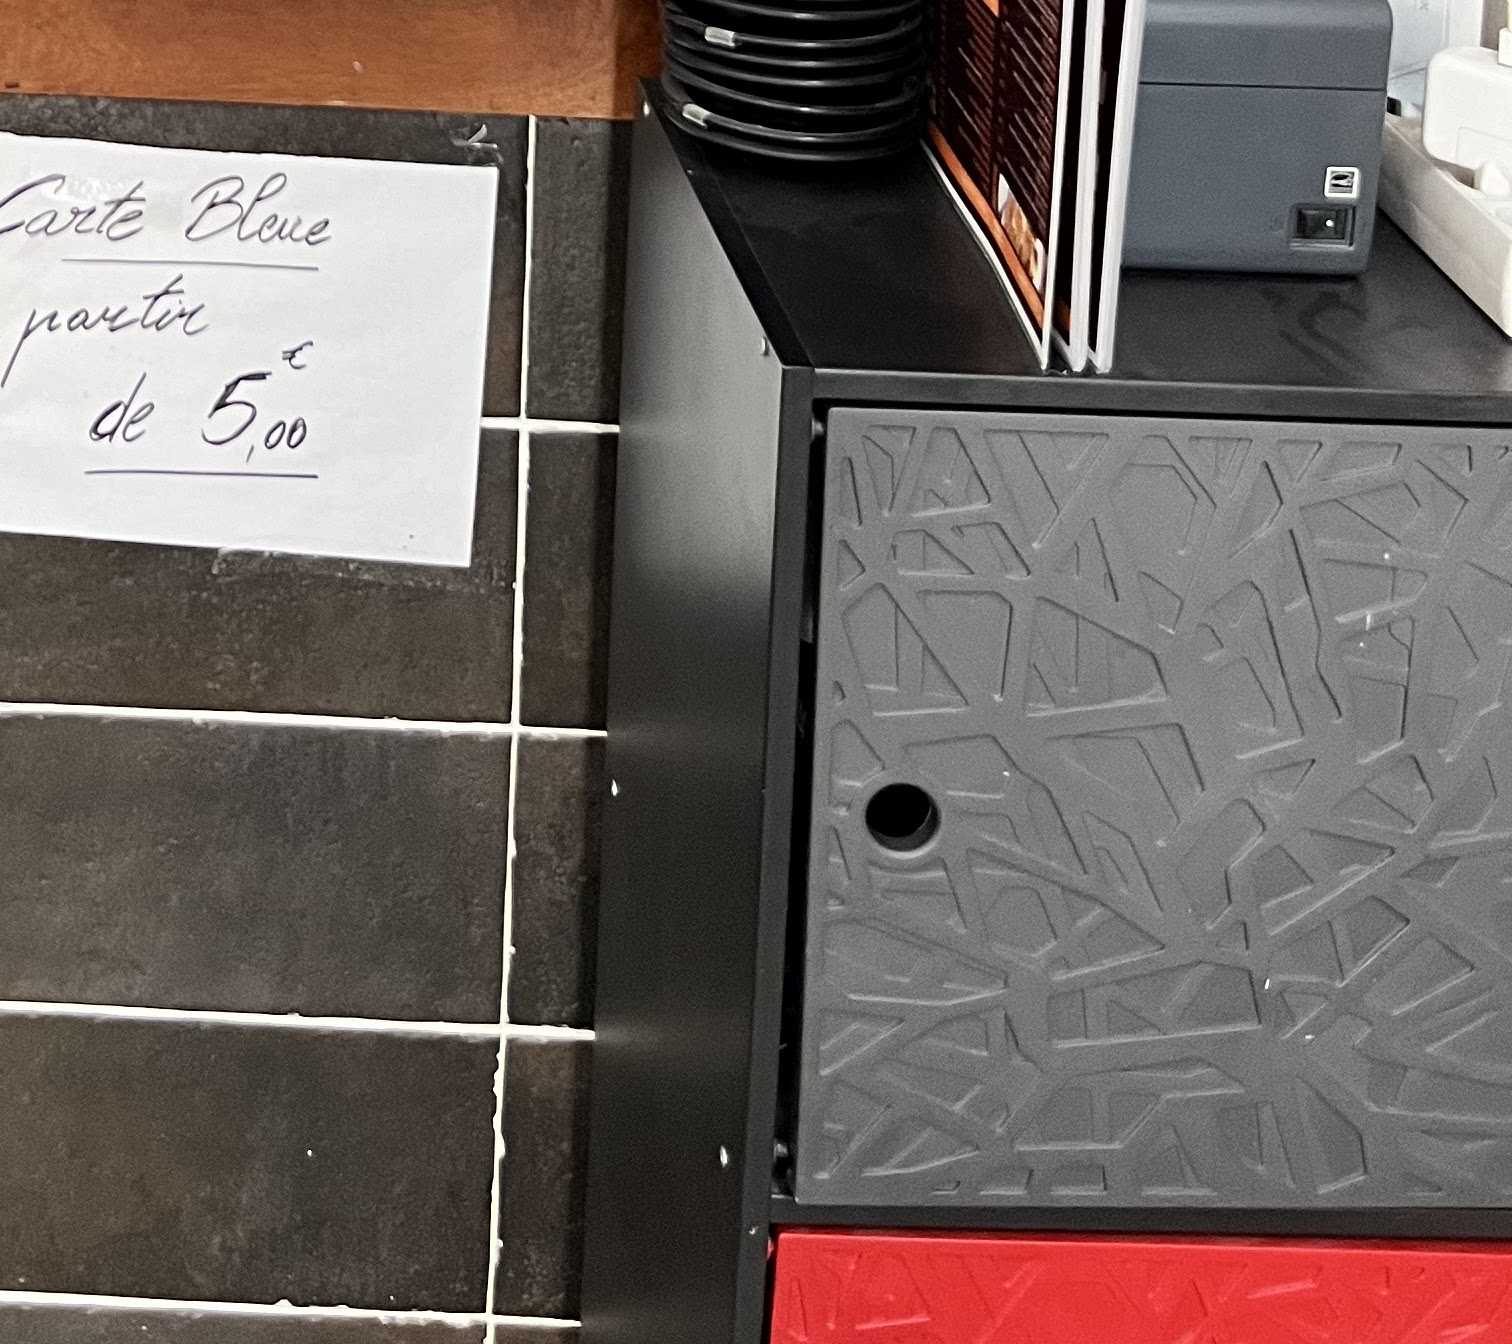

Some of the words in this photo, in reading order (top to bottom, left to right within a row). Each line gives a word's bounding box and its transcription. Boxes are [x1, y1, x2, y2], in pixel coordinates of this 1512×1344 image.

[184, 172, 333, 247] Bleue
[0, 274, 209, 388] partir
[87, 372, 156, 443] de
